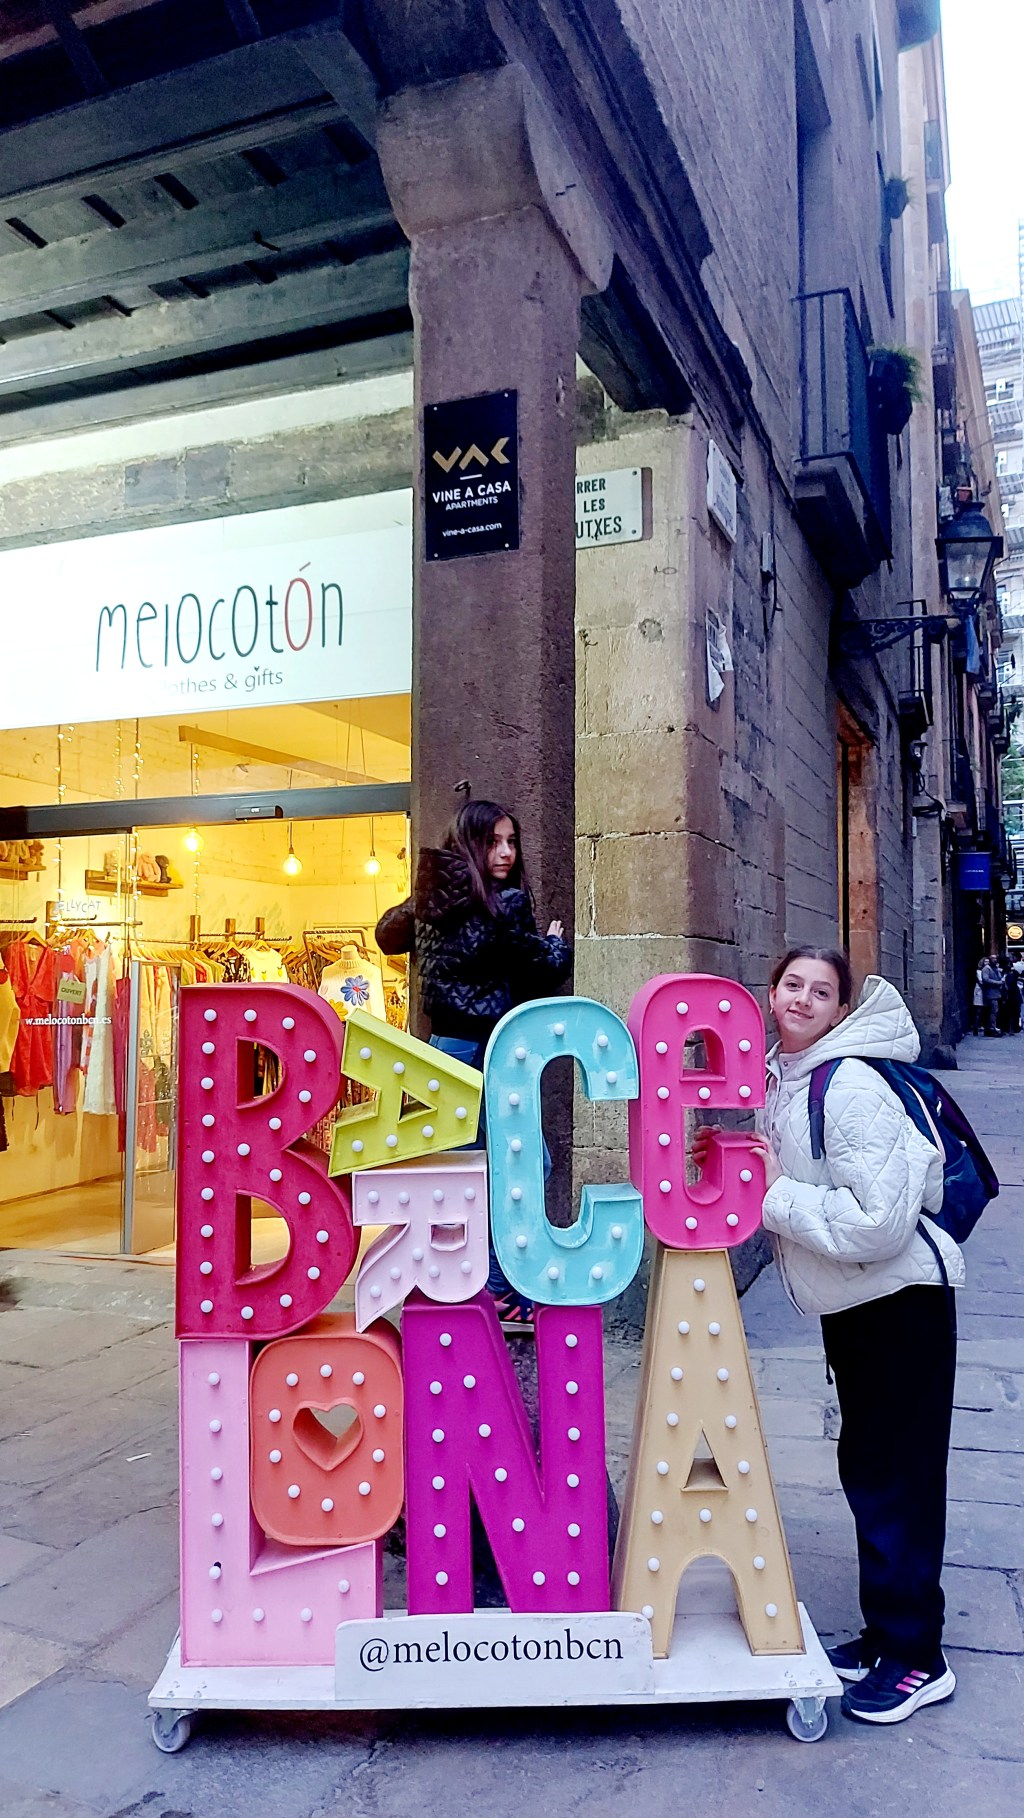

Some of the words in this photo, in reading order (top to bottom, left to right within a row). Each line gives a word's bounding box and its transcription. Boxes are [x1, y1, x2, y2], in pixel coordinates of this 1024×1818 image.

[432, 488, 461, 503] VINE
[465, 486, 474, 498] A
[477, 480, 511, 496] CASA
[576, 478, 606, 494] RRER
[445, 496, 499, 511] APARTMENTS
[583, 498, 605, 513] LES
[442, 522, 502, 537] vine-a-casa.com
[224, 673, 238, 690] &
[245, 665, 283, 692] gifts
[61, 987, 82, 996] OUVERT
[359, 1628, 624, 1672] @melocotonbcn
